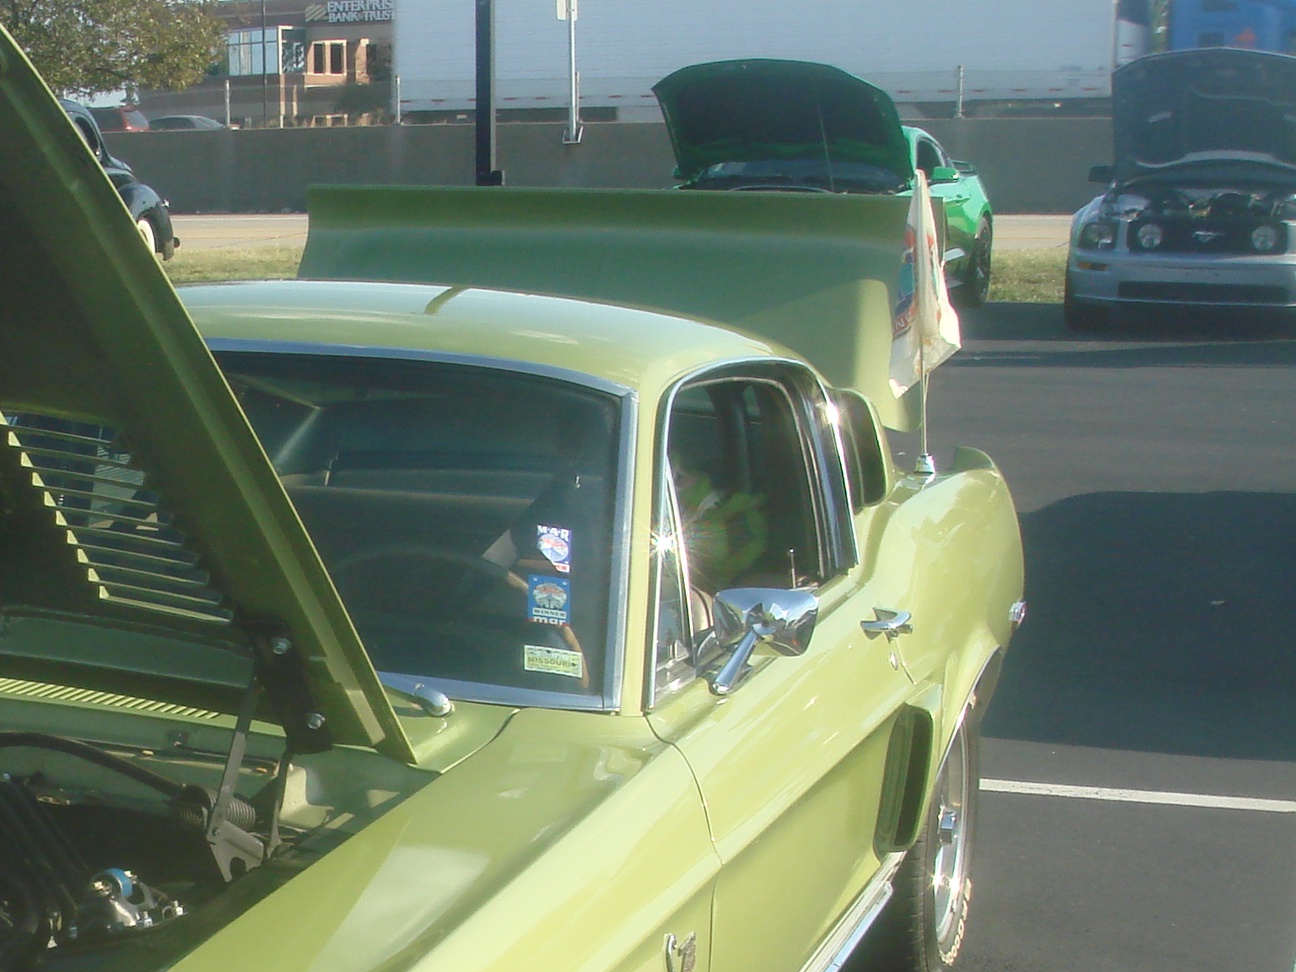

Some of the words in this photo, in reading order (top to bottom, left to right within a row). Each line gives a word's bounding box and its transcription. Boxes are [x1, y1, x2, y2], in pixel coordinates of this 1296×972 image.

[327, 0, 394, 12] ENTERPRIS
[328, 11, 358, 23] BANK
[364, 10, 394, 22] TRUST
[527, 656, 571, 668] MISSOURI
